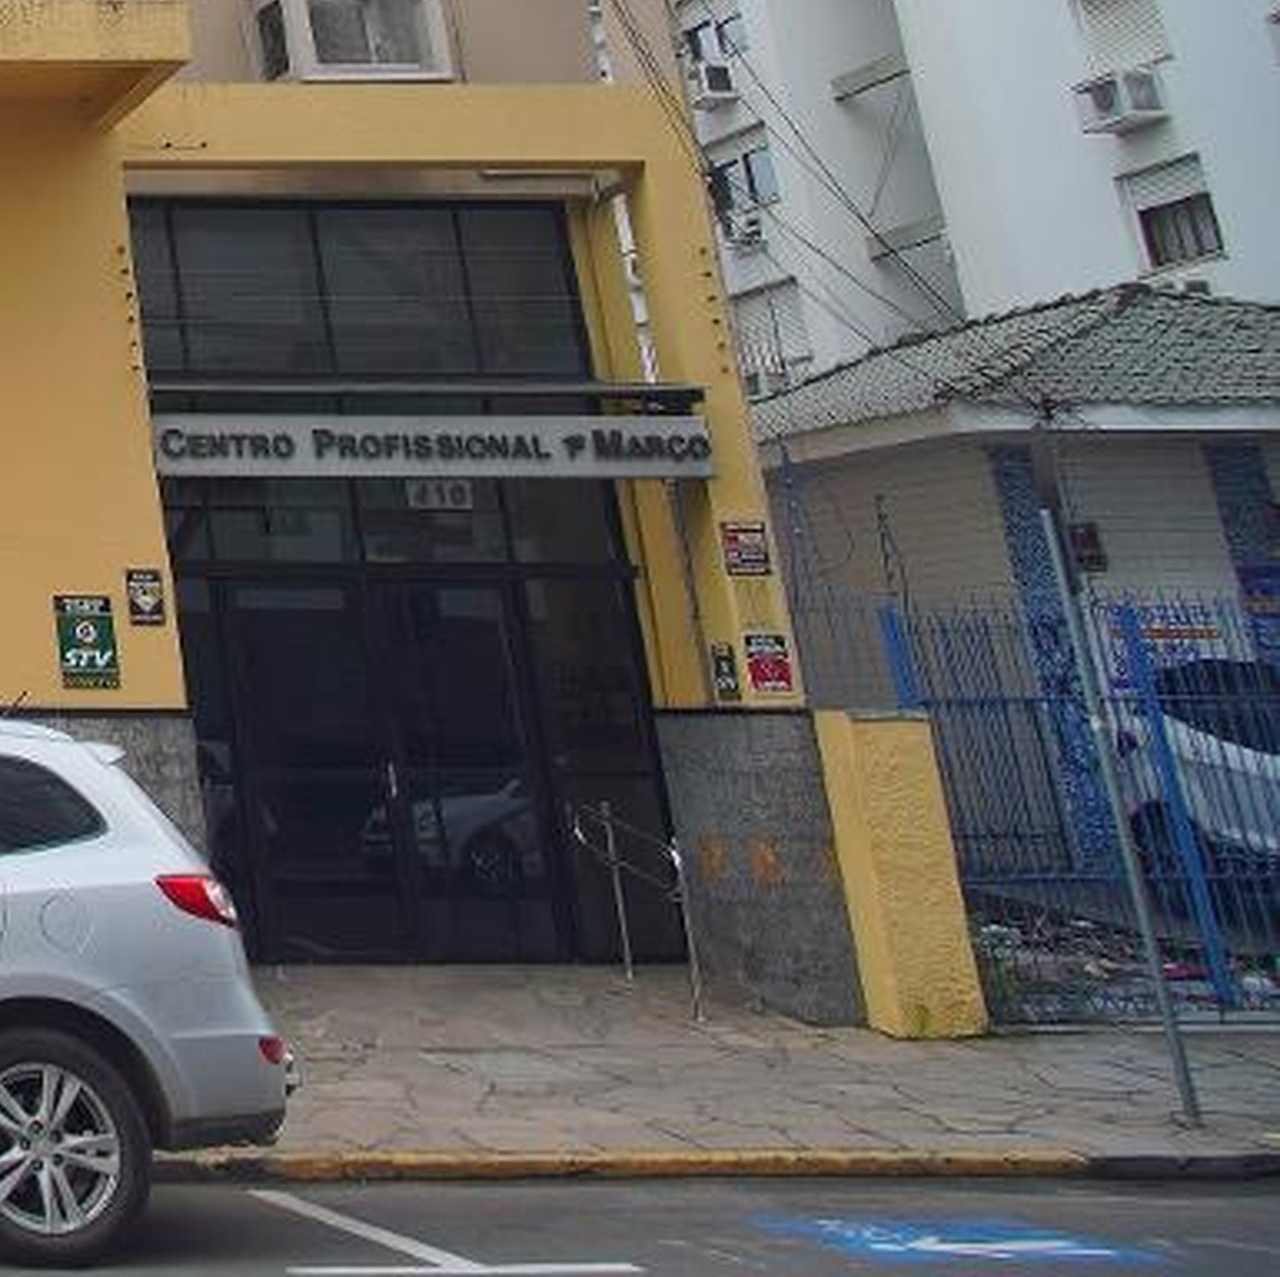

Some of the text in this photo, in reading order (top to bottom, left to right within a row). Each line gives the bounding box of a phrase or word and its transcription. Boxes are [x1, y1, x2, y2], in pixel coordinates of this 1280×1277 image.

[159, 427, 296, 459] CENTRO
[311, 427, 552, 461] PROFISSIONAL
[63, 648, 113, 667] STV
